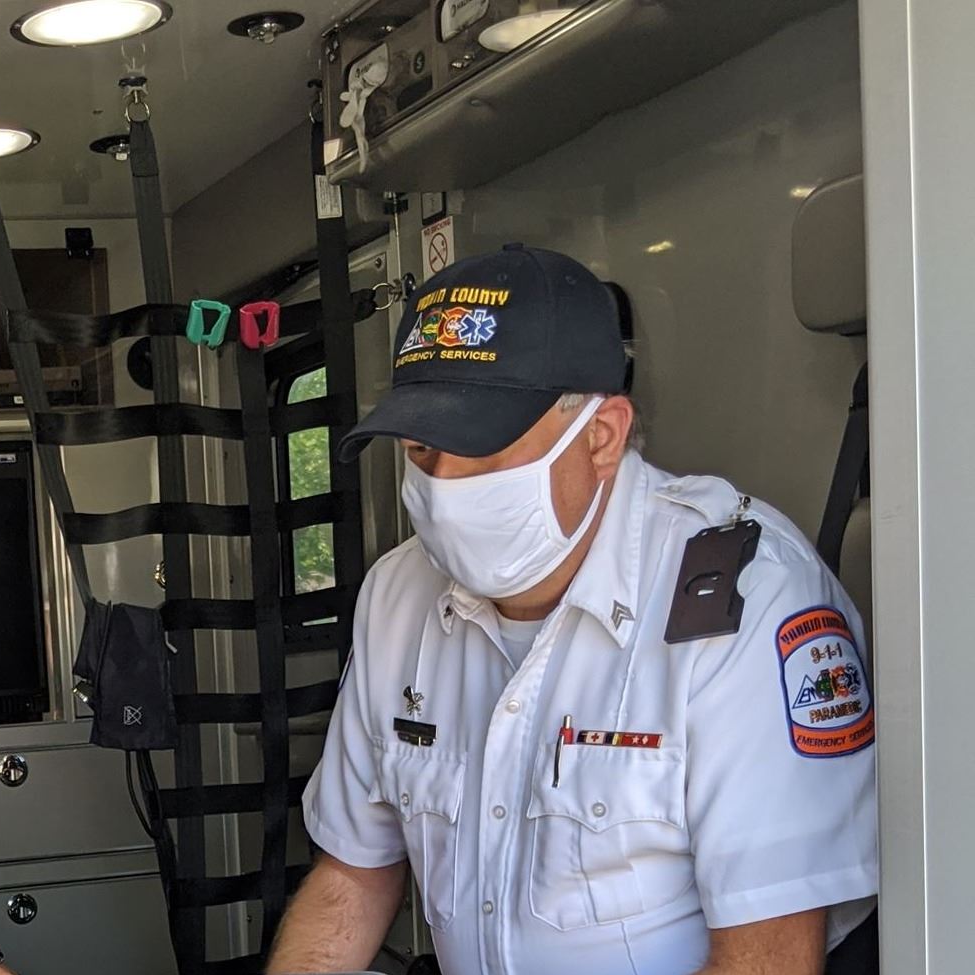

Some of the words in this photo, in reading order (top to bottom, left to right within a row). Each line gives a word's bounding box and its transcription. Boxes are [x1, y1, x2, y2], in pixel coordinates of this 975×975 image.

[450, 287, 510, 306] COUNTY
[440, 350, 497, 361] SERVICES
[810, 642, 843, 664] 9-1-1
[809, 700, 862, 724] PARAMEDIC
[796, 733, 847, 748] EMERGENCY
